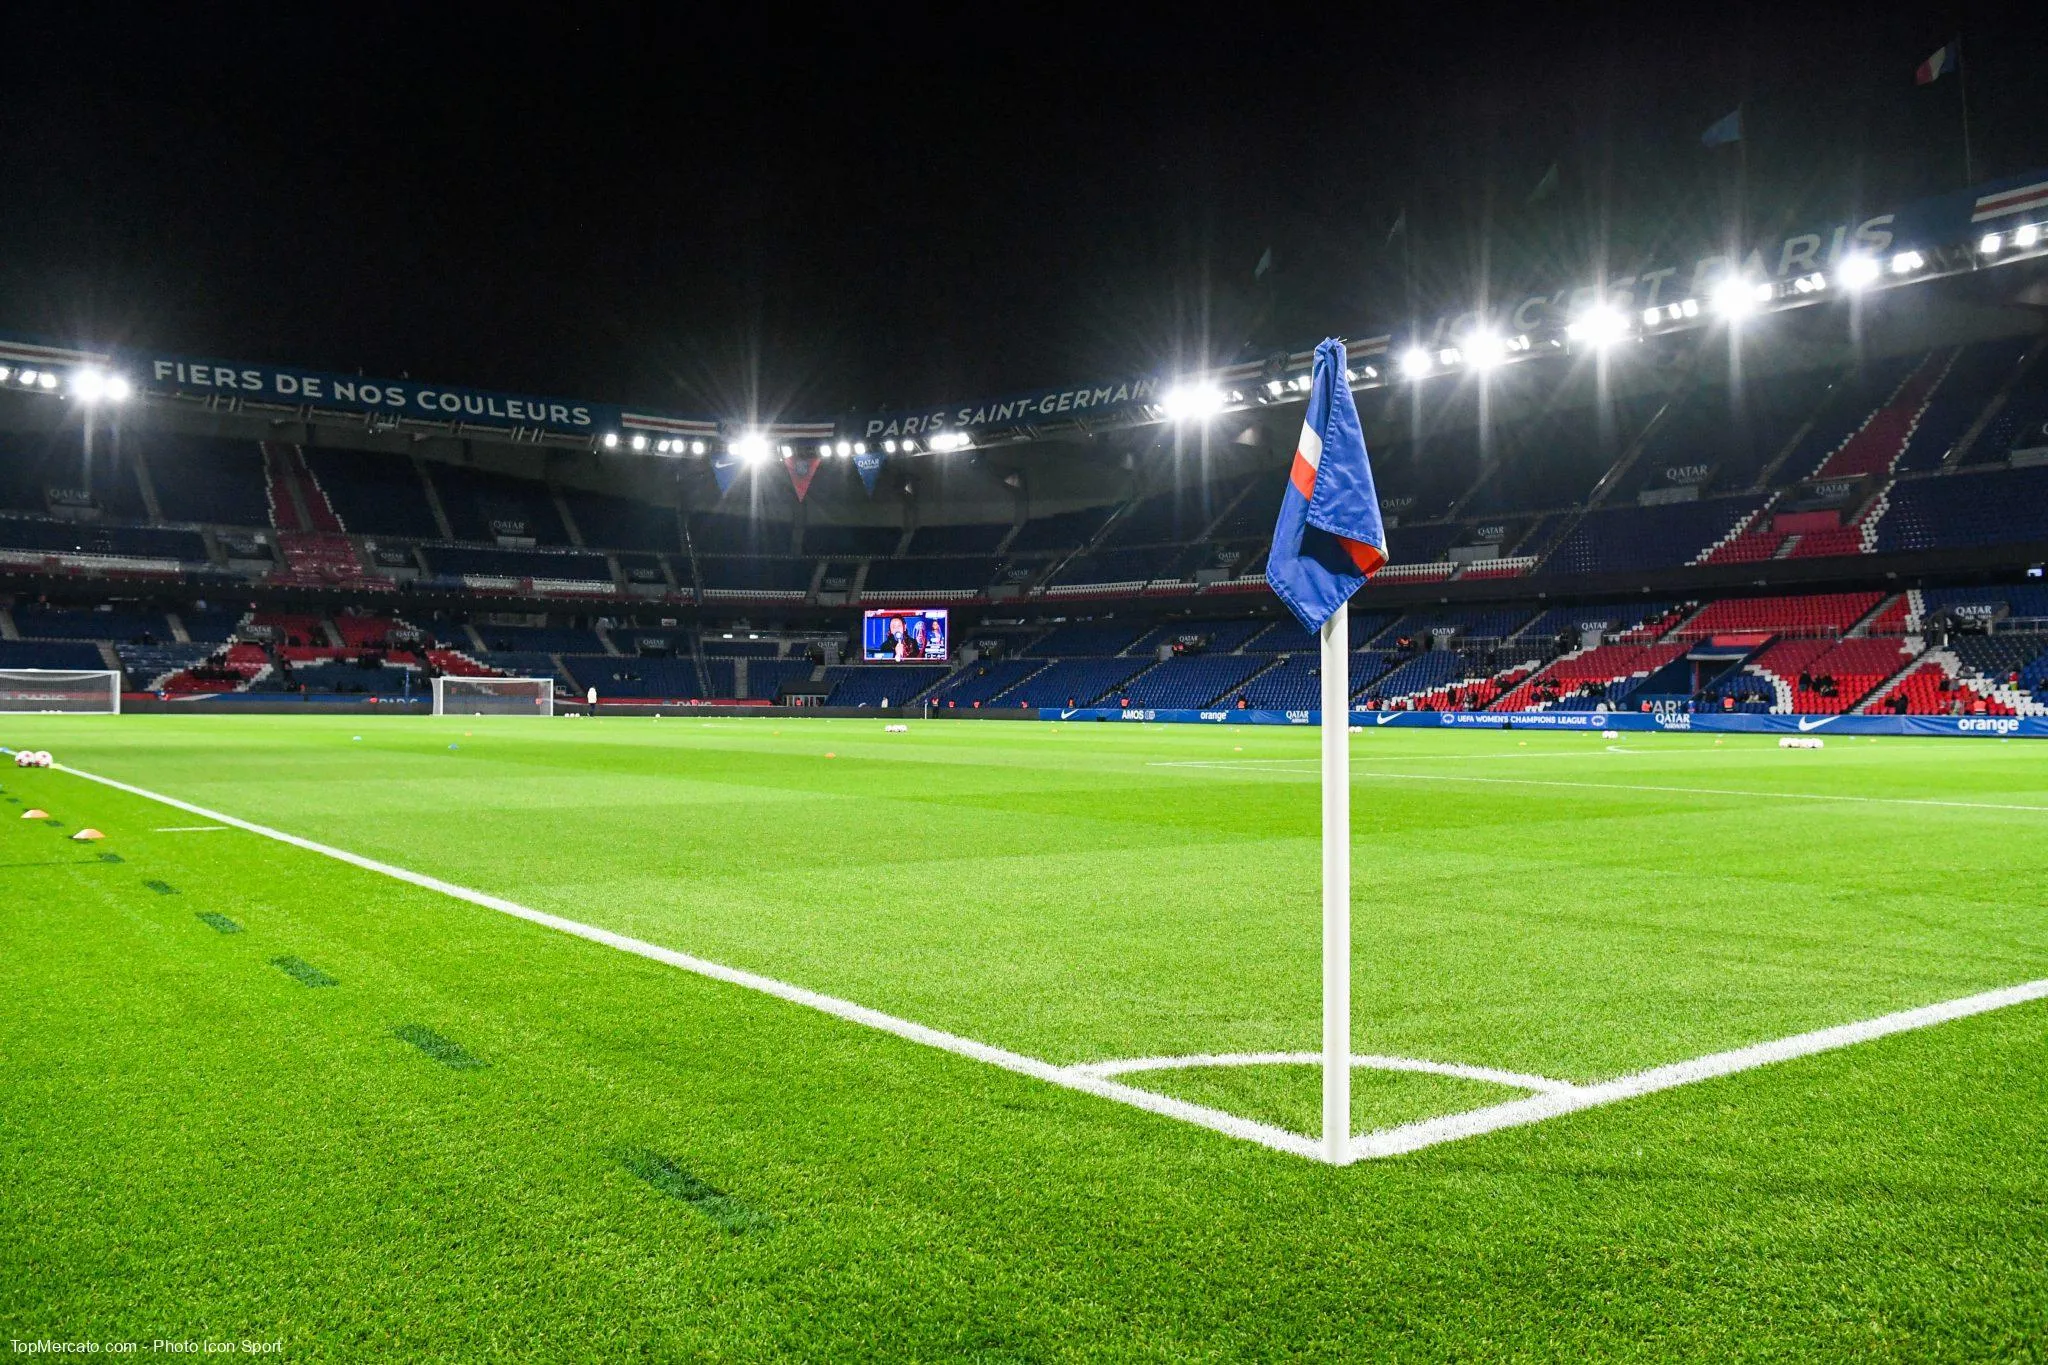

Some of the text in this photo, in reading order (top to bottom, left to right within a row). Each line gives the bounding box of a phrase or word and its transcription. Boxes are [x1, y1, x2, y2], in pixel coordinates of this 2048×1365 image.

[153, 360, 592, 425] FIERS DE NOS COULEURS
[866, 379, 1160, 437] PARIS SAINT-GERMAIN
[857, 457, 880, 468] QATAR
[1666, 464, 1708, 480] QATAR
[1816, 484, 1850, 496] QATAR
[1478, 526, 1504, 537] QATAR
[1955, 605, 1992, 617] QATAR
[1432, 628, 1456, 636] QATAR
[1582, 622, 1608, 631] QATAR
[1121, 709, 1144, 720] AMOS
[1200, 711, 1227, 722] orange
[1285, 710, 1309, 721] QATAR
[1457, 715, 1474, 723] UEFA
[1510, 716, 1556, 724] CHAMPIONS
[1557, 716, 1587, 724] LEAGUE
[1655, 713, 1690, 725] QATAR
[1957, 718, 2019, 734] orange
